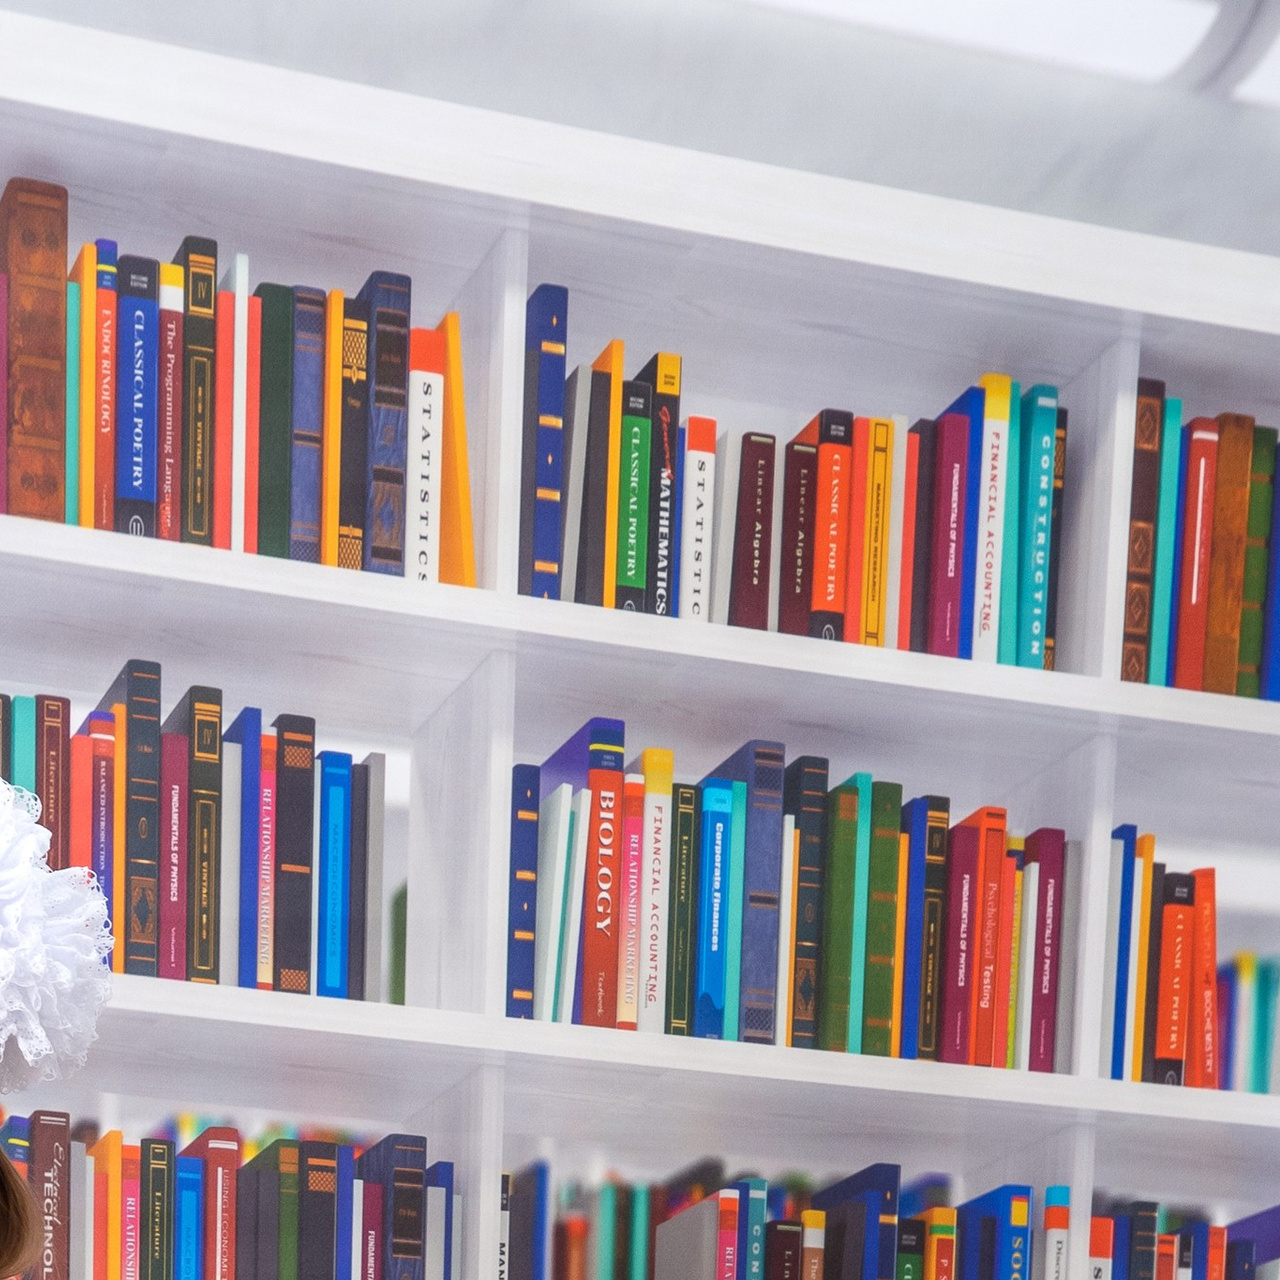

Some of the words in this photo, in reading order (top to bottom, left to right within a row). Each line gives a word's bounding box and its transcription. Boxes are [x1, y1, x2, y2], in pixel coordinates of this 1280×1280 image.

[98, 308, 111, 435] ENDOCRINOLOGY
[131, 308, 146, 414] CLASSICAL
[164, 320, 176, 350] The
[163, 353, 176, 461] Programming
[130, 418, 143, 491] POETRY
[628, 425, 640, 507] CLASSICAL
[755, 458, 765, 515] Linear
[986, 431, 1001, 523] FINANCIAL
[829, 452, 841, 543] CLASSICAL
[626, 509, 639, 580] POETRY
[653, 467, 672, 616] MATHEMATICS
[752, 520, 762, 586] Algebra
[794, 530, 805, 594] Algebra
[825, 544, 837, 602] POETRY
[980, 529, 996, 632] ACCOUNTING
[1029, 435, 1051, 655] CONSTRUCTION
[170, 784, 180, 852] FUNDAMENTALS
[259, 788, 273, 889] RELATIONSHIP
[649, 803, 664, 896] FINANCIAL
[169, 864, 178, 902] PHYSICS
[594, 787, 617, 938] BIOLOGY
[628, 832, 640, 928] RELATIONSHIP
[258, 889, 270, 966] MARKETING
[624, 929, 638, 1006] MARKETING
[646, 902, 662, 1003] ACCOUNTING
[979, 962, 995, 1009] Testing
[809, 1256, 819, 1278] The
